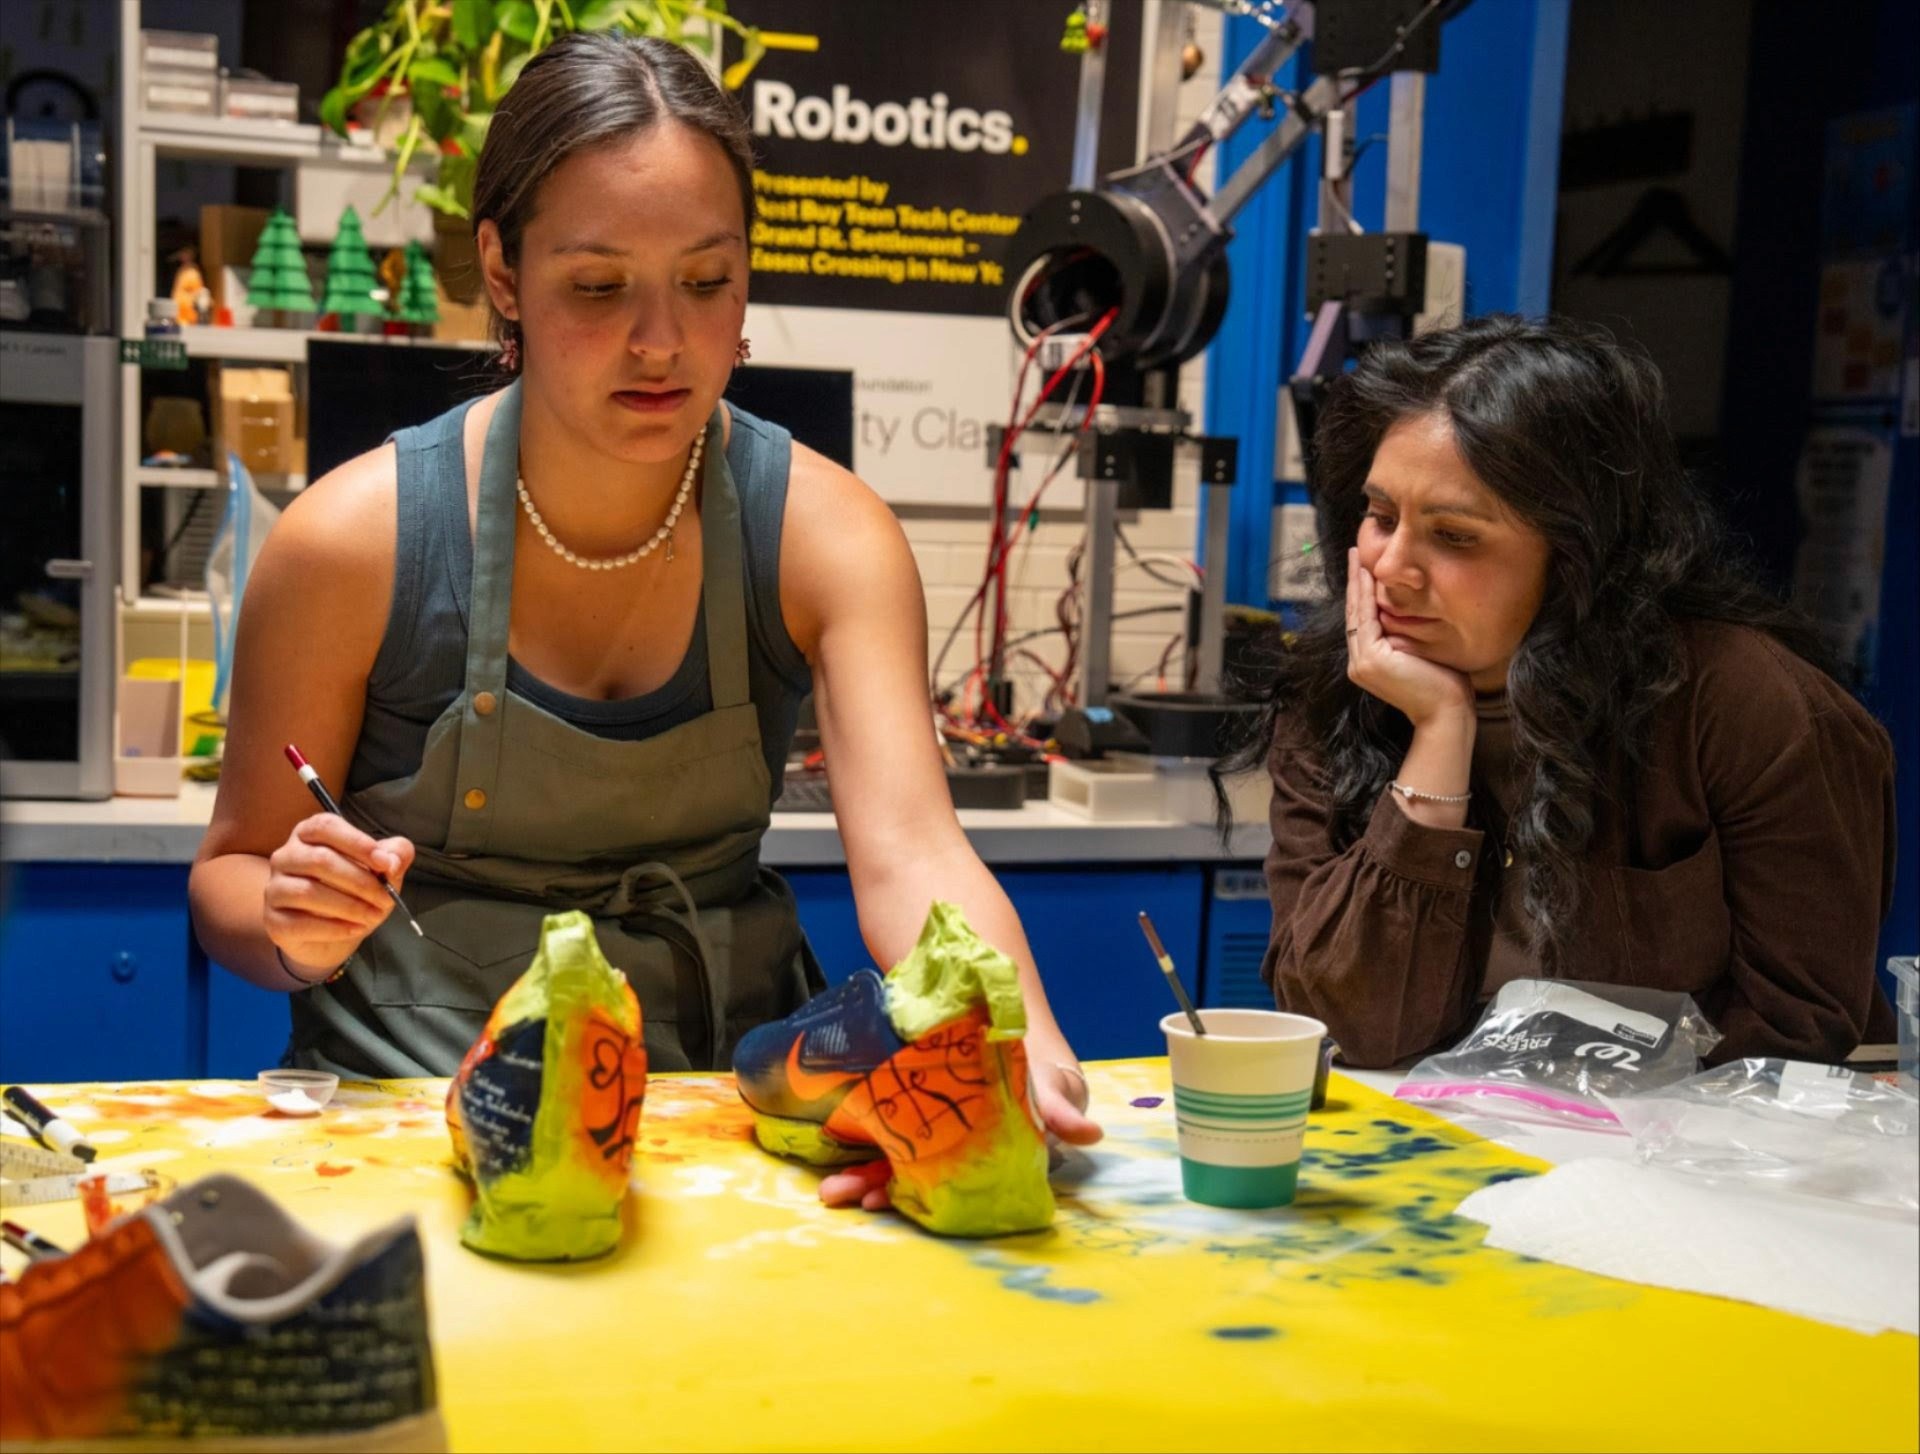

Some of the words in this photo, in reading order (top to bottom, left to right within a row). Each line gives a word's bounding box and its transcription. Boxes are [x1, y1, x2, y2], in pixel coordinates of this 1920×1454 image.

[753, 79, 1029, 154] Robotics.
[752, 169, 859, 200] Presented
[860, 175, 890, 205] by
[800, 199, 843, 227] Buy
[896, 204, 948, 231] Tech
[949, 208, 1022, 236] Center
[811, 250, 906, 284] Crossing
[906, 256, 928, 281] in
[929, 258, 978, 284] New
[861, 411, 901, 454] ty
[911, 406, 982, 451] Cla
